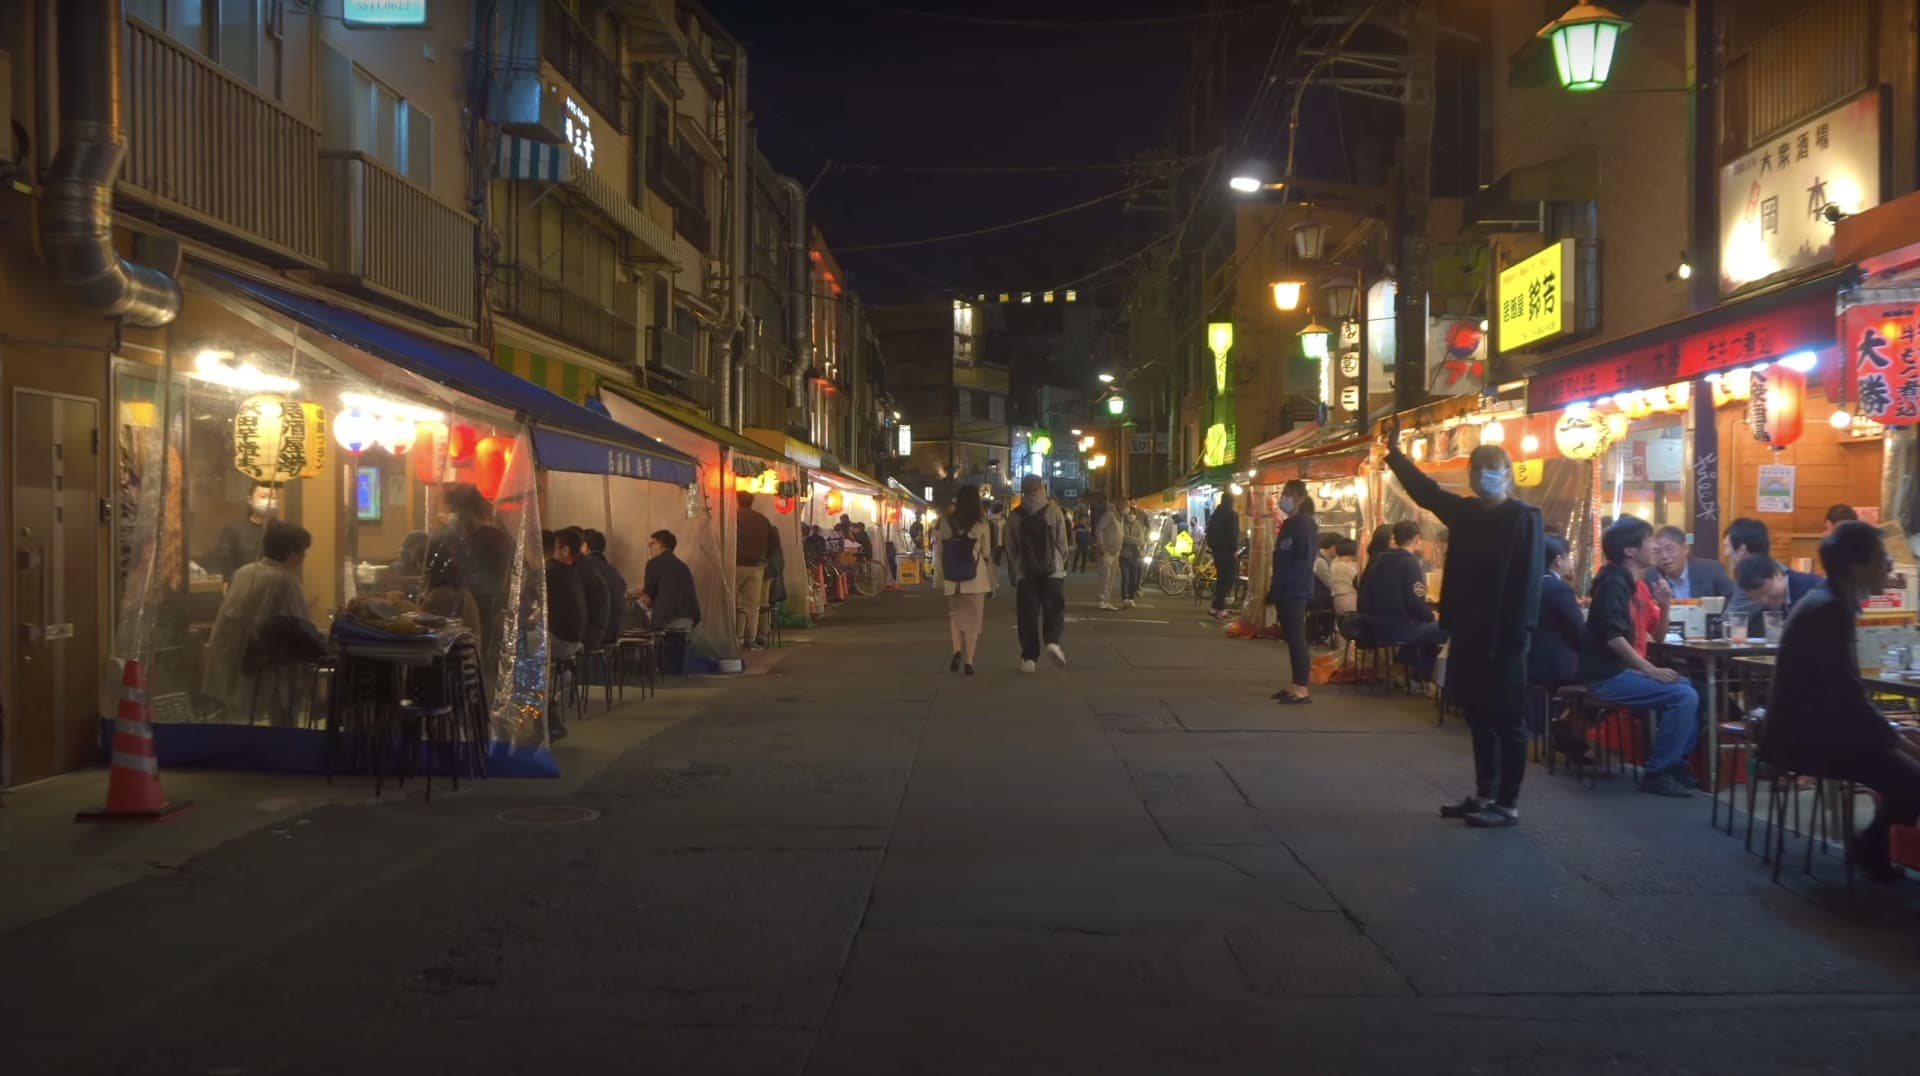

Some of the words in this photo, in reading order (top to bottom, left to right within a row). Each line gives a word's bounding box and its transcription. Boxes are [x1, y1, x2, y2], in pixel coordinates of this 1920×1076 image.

[1760, 123, 1830, 176] 大衆酒場
[1760, 176, 1829, 242] 岡本
